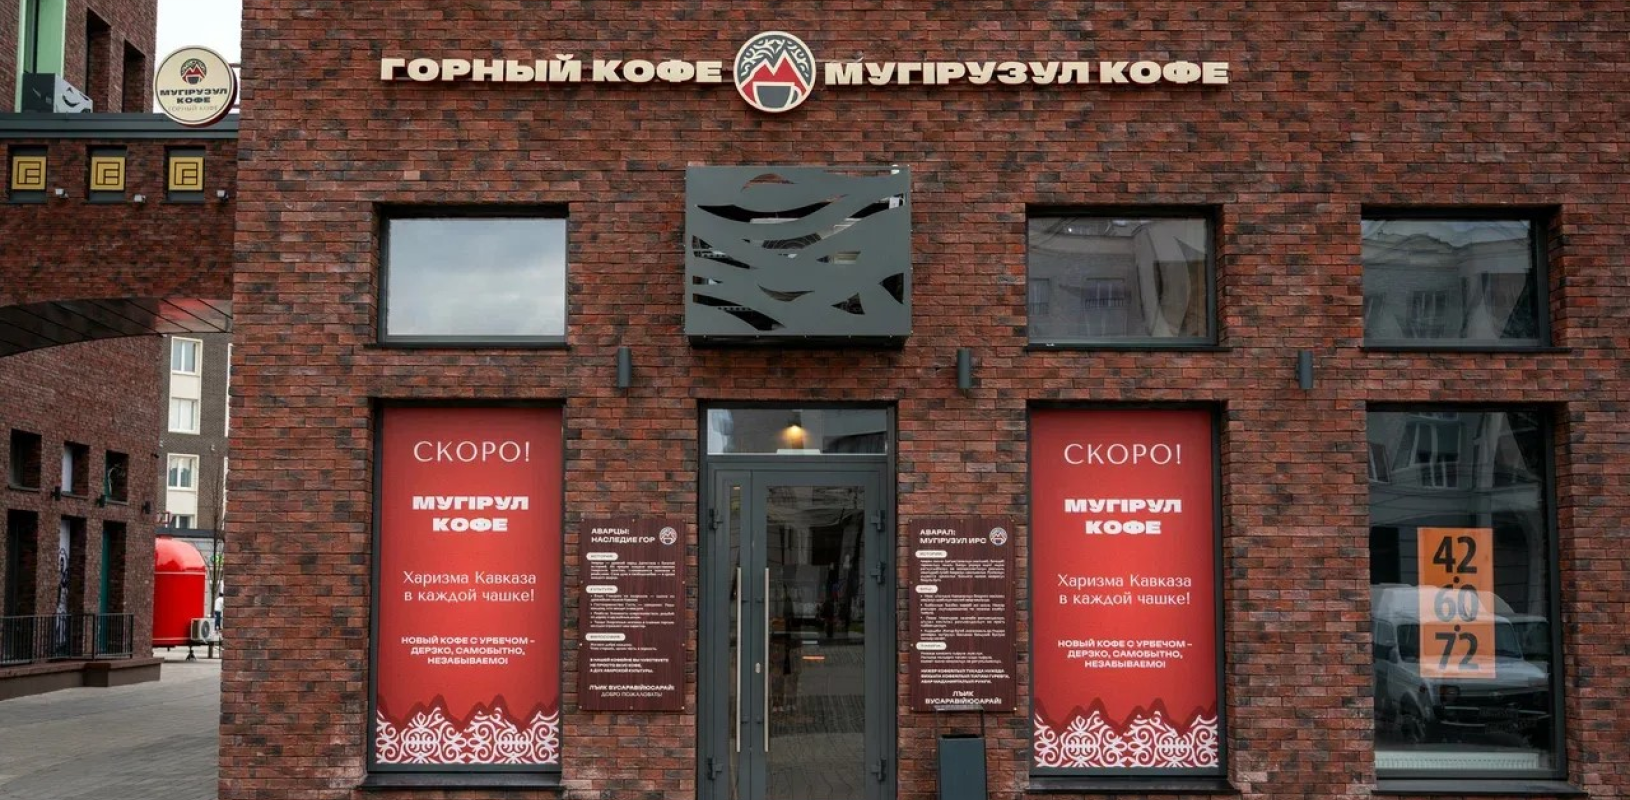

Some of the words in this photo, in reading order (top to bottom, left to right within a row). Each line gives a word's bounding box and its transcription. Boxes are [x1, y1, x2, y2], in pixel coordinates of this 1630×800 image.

[380, 53, 582, 82] ГОРНЫЙ
[592, 59, 723, 83] КОФЕ
[1099, 60, 1230, 85] КОФЕ
[413, 440, 530, 463] СКОРО!
[1064, 443, 1182, 465] СКОРО!
[432, 517, 509, 533] КОФЕ
[1085, 520, 1162, 535] КОФЕ
[1432, 536, 1477, 574] 42
[403, 571, 470, 587] Харизма
[475, 571, 537, 584] Кавказа
[1057, 574, 1124, 590] Харизма
[1130, 574, 1192, 587] Кавказа
[404, 591, 412, 602] в
[418, 589, 477, 603] каждой
[482, 589, 535, 602] чашке!
[1059, 595, 1068, 605] в
[1073, 592, 1132, 606] каждой
[1137, 592, 1191, 605] чашке!
[1434, 583, 1478, 622] 60
[401, 636, 438, 645] НОВЫЙ
[440, 637, 468, 645] КОФЕ
[470, 637, 478, 645] С
[479, 637, 529, 645] УРБЕЧОМ
[1058, 639, 1095, 648] НОВЫЙ
[1097, 640, 1125, 648] КОФЕ
[1126, 640, 1135, 648] С
[1136, 640, 1186, 648] УРБЕЧОМ
[411, 647, 454, 656] ДЕРЗКО,
[456, 647, 526, 656] САМОБЫТНО,
[1067, 650, 1111, 659] ДЕРЗКО,
[1112, 650, 1183, 660] САМОБЫТНО,
[1435, 632, 1478, 670] 72
